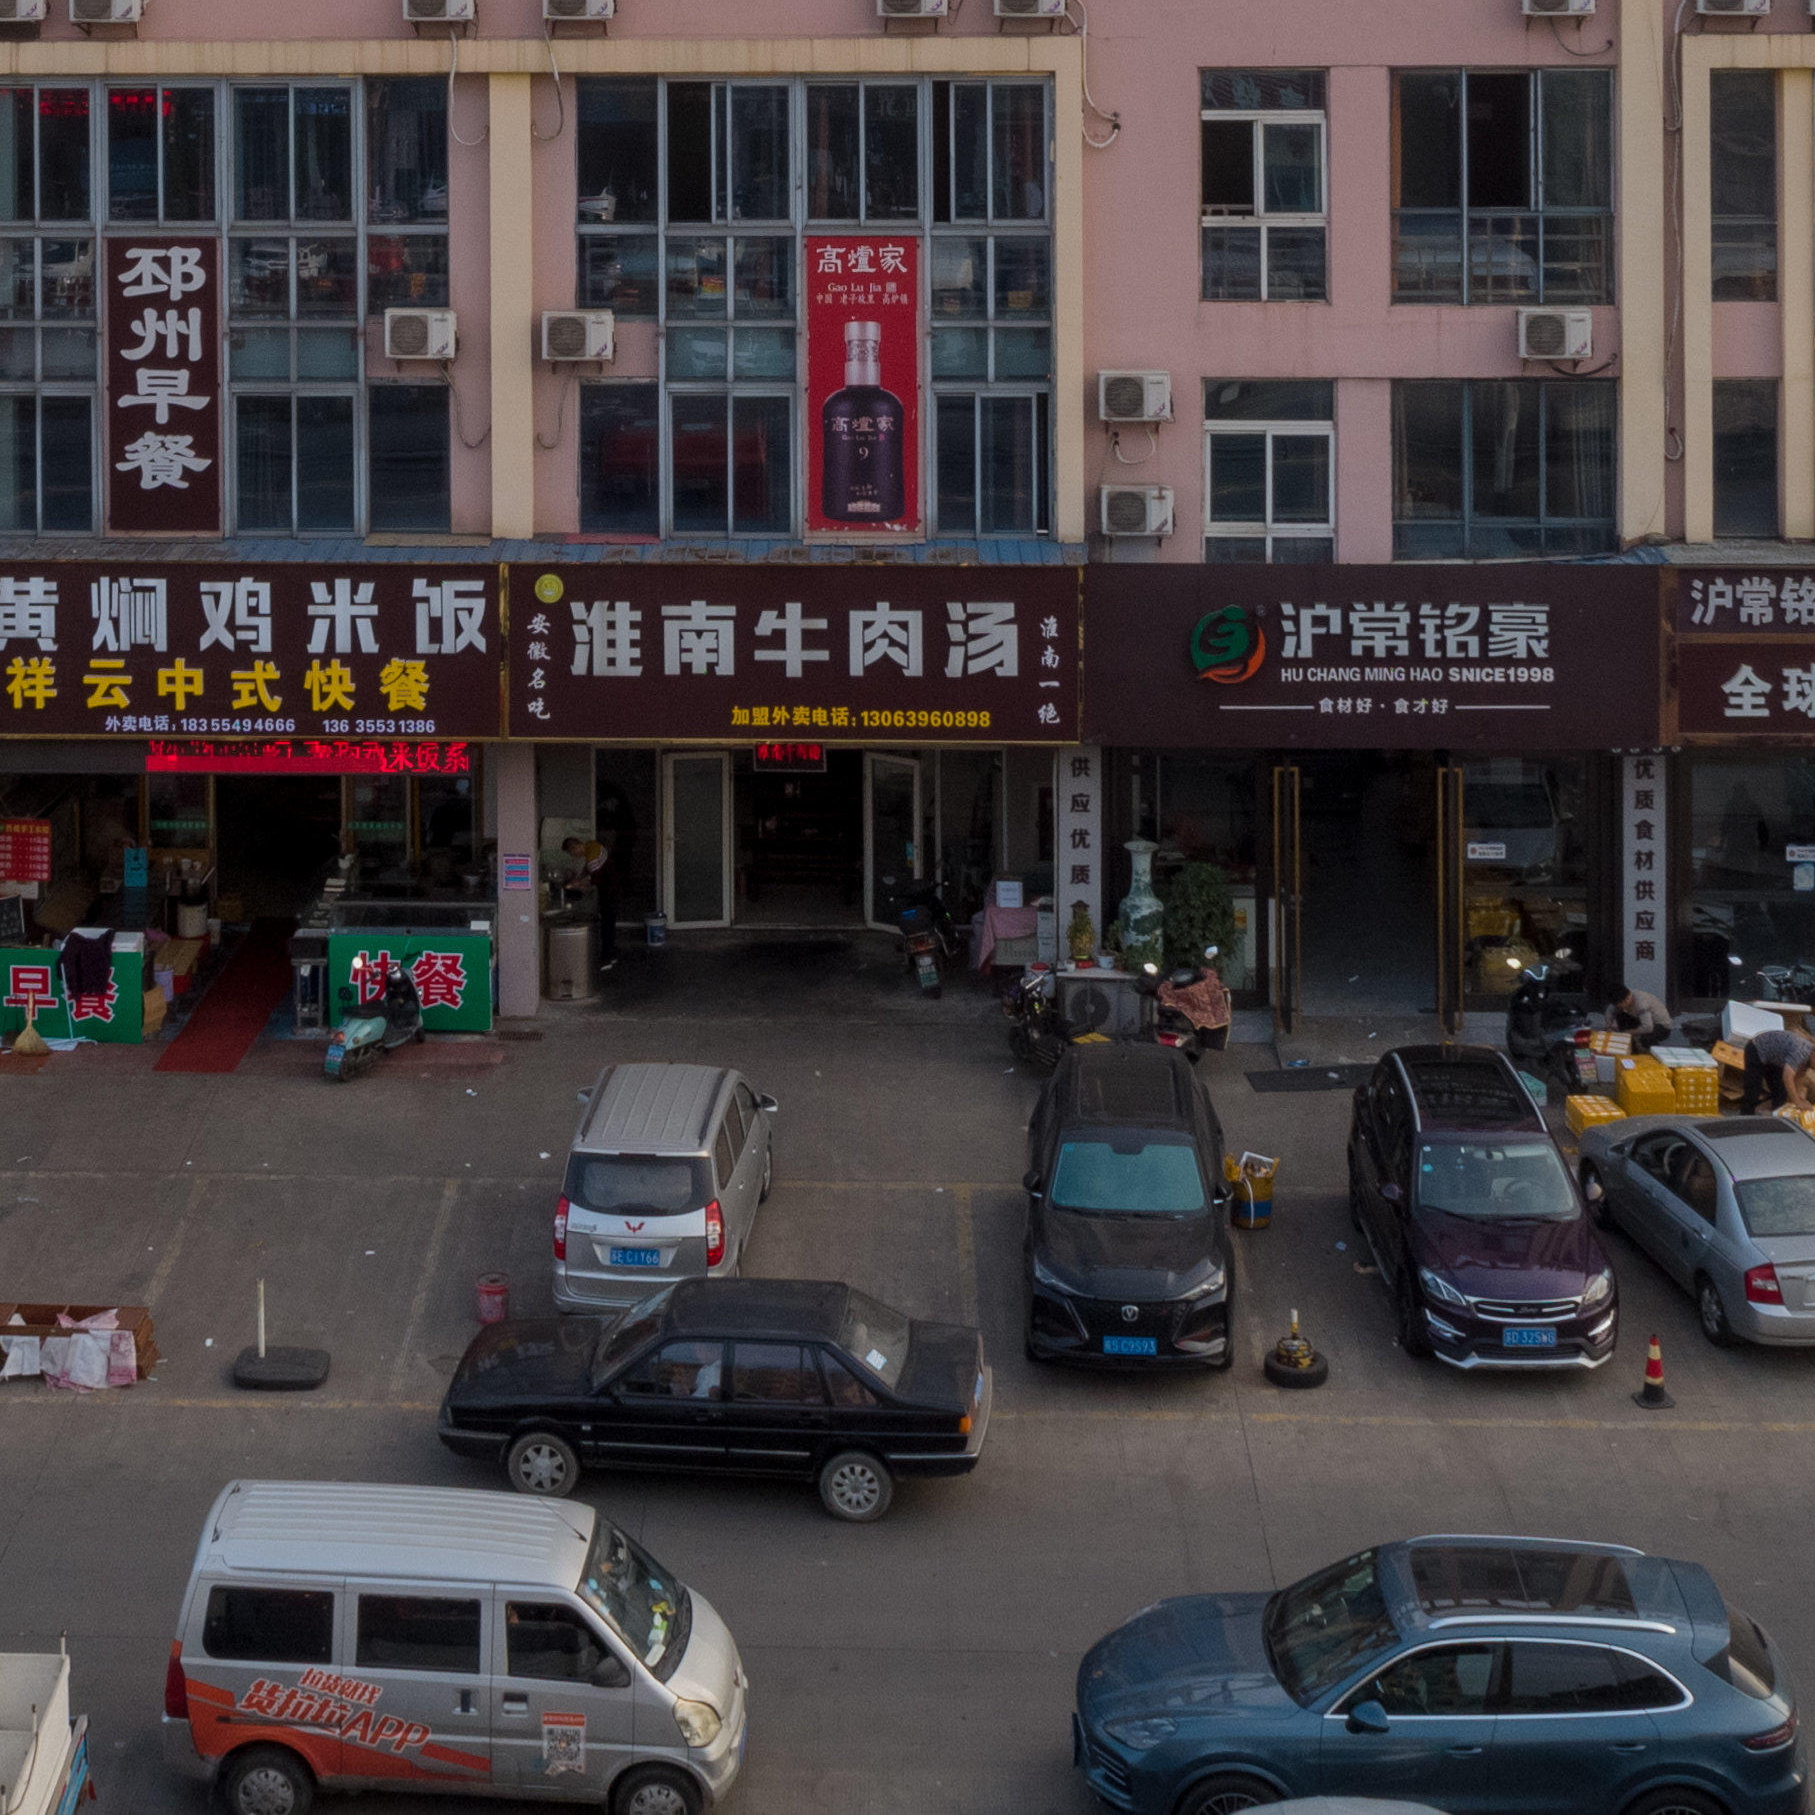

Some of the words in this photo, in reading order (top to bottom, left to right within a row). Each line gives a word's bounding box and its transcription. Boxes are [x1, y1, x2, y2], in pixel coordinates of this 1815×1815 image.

[115, 246, 212, 490] 邳州早餐
[858, 446, 870, 461] 9
[526, 612, 550, 721] 安徽名吃
[569, 600, 1019, 678] 淮南牛肉汤
[1037, 615, 1060, 724] 淮南一绝
[1280, 602, 1551, 661] 沪常铭豪
[4, 657, 431, 714] 祥云中式快餐
[1281, 666, 1304, 683] HU
[1307, 666, 1362, 684] CHANG
[1364, 666, 1407, 684] MING
[1409, 666, 1444, 684] HAO
[1447, 666, 1555, 684] SNICE1998
[1633, 756, 1657, 962] 优质食材供应商
